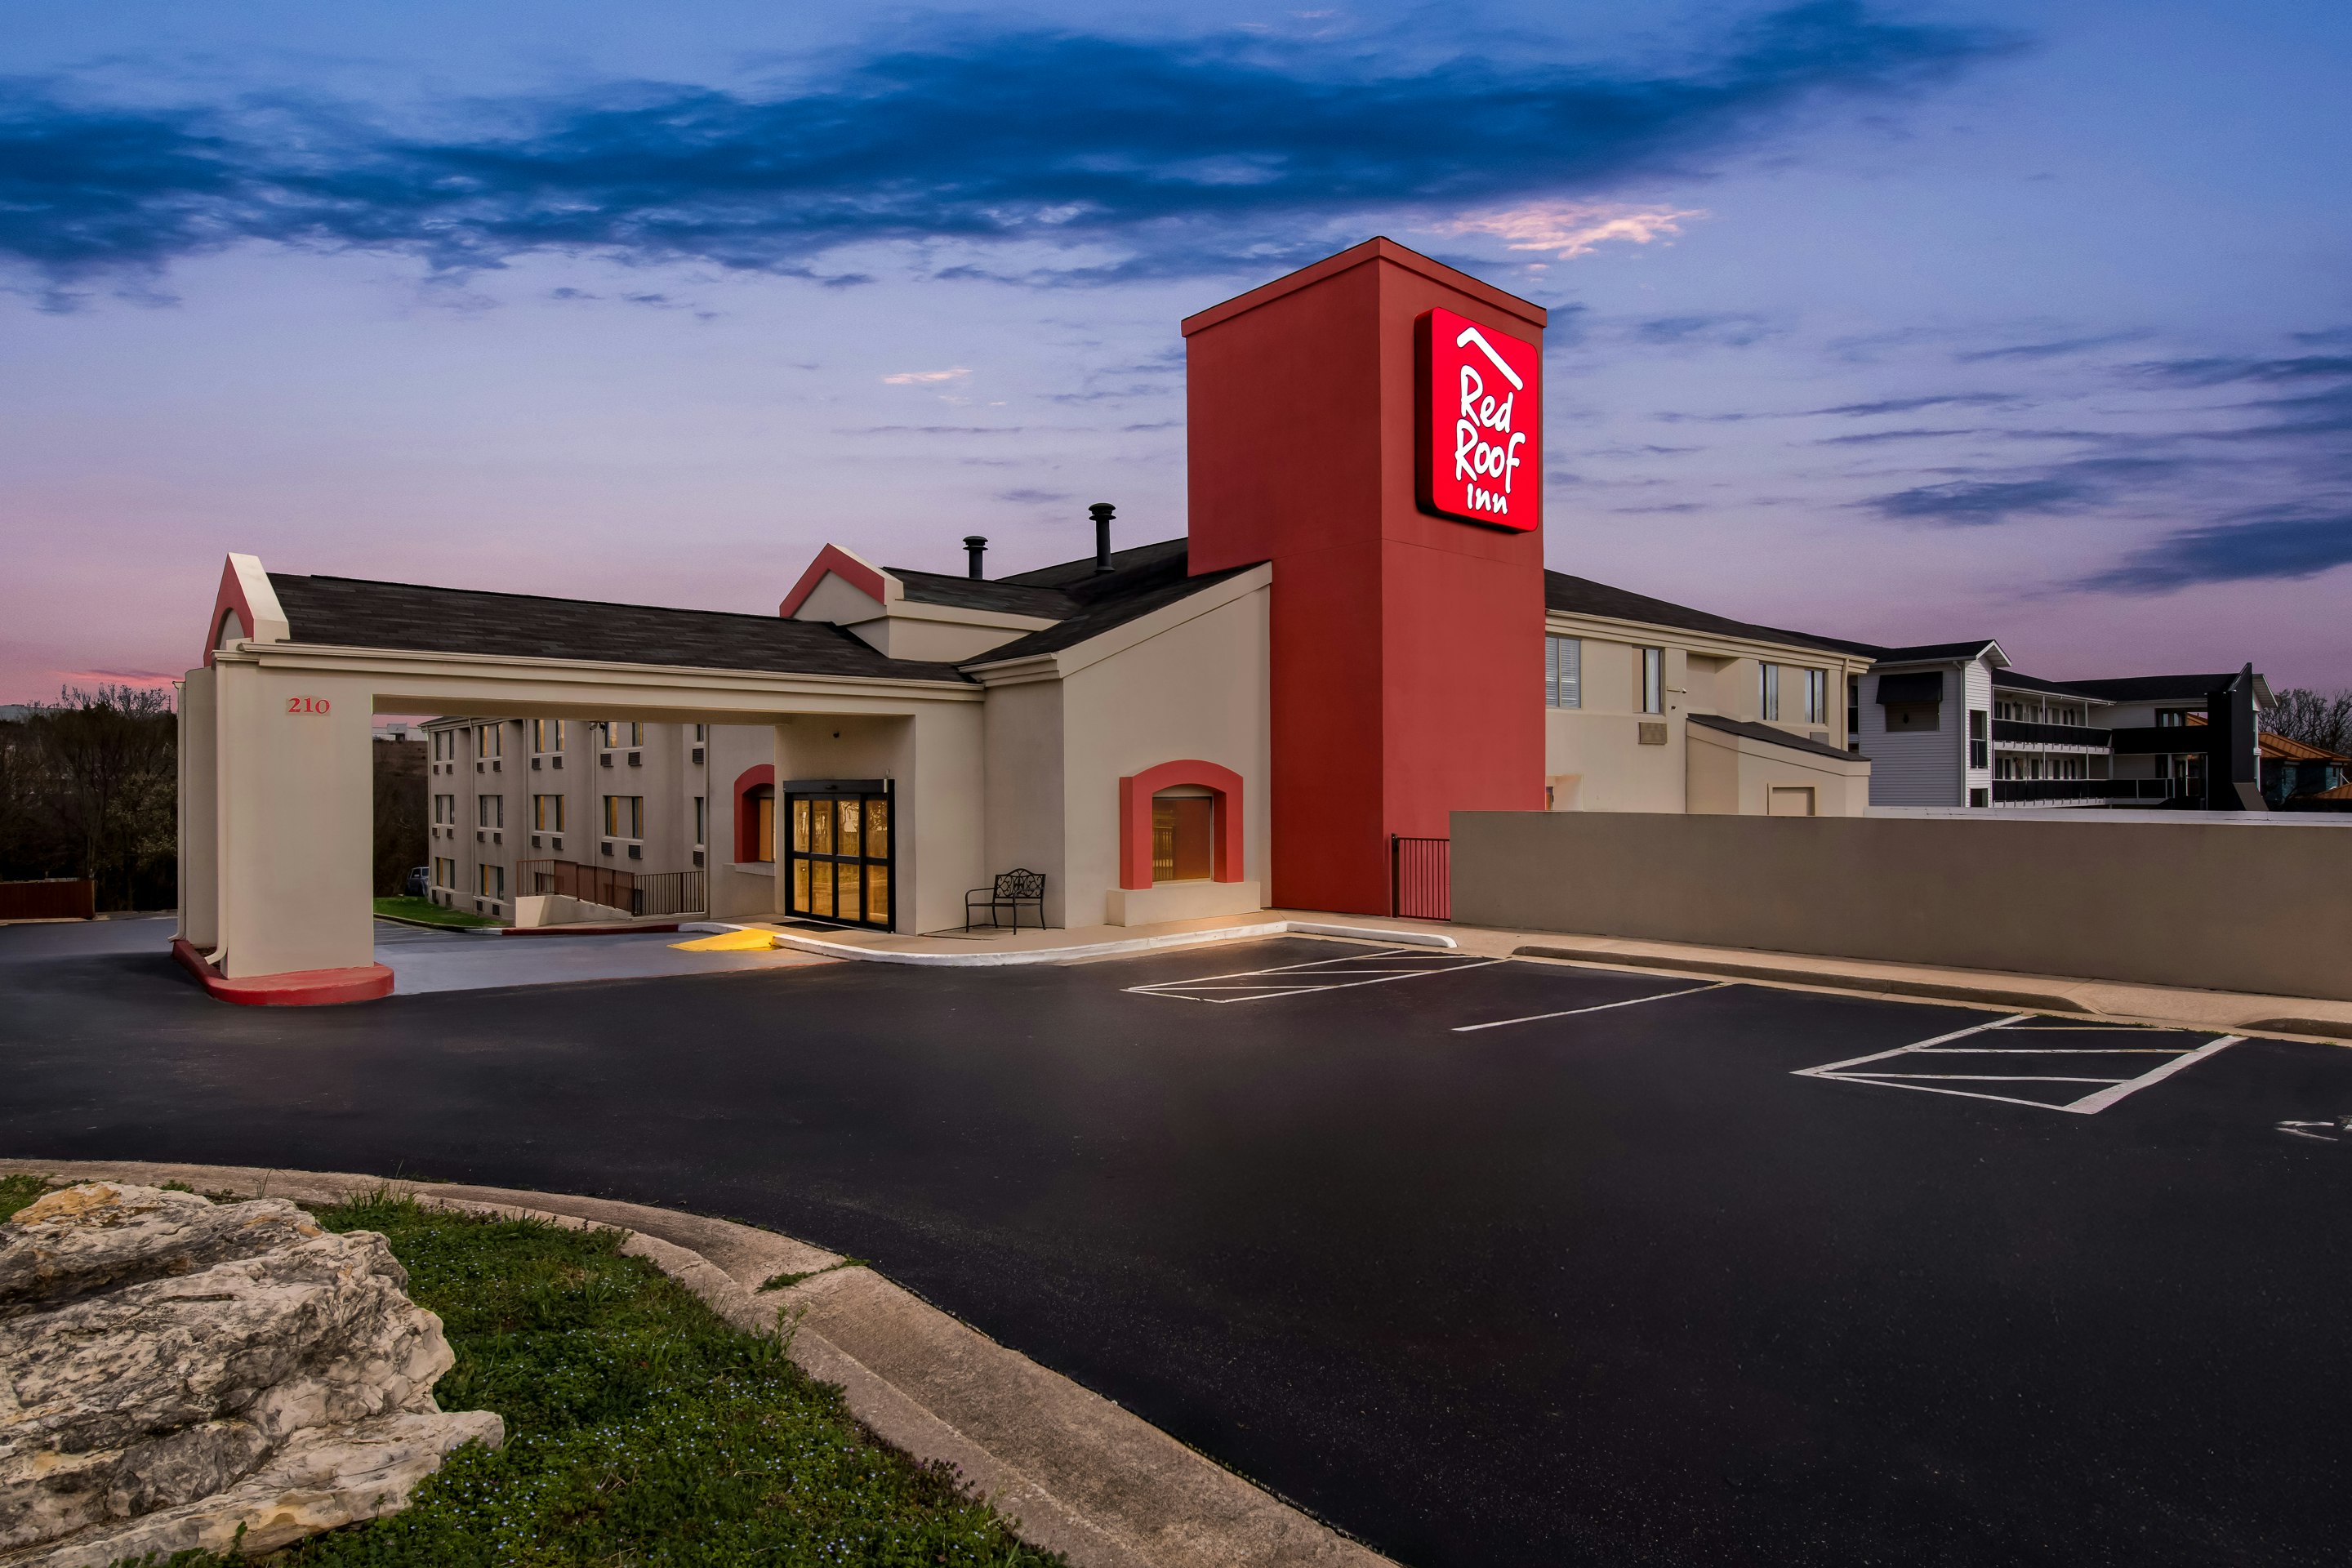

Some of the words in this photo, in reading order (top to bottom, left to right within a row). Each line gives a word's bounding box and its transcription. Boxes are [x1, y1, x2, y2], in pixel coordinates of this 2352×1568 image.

[1460, 364, 1513, 434] Red
[1454, 418, 1526, 494] Roof
[1467, 483, 1508, 515] Inn
[287, 697, 331, 715] 210
